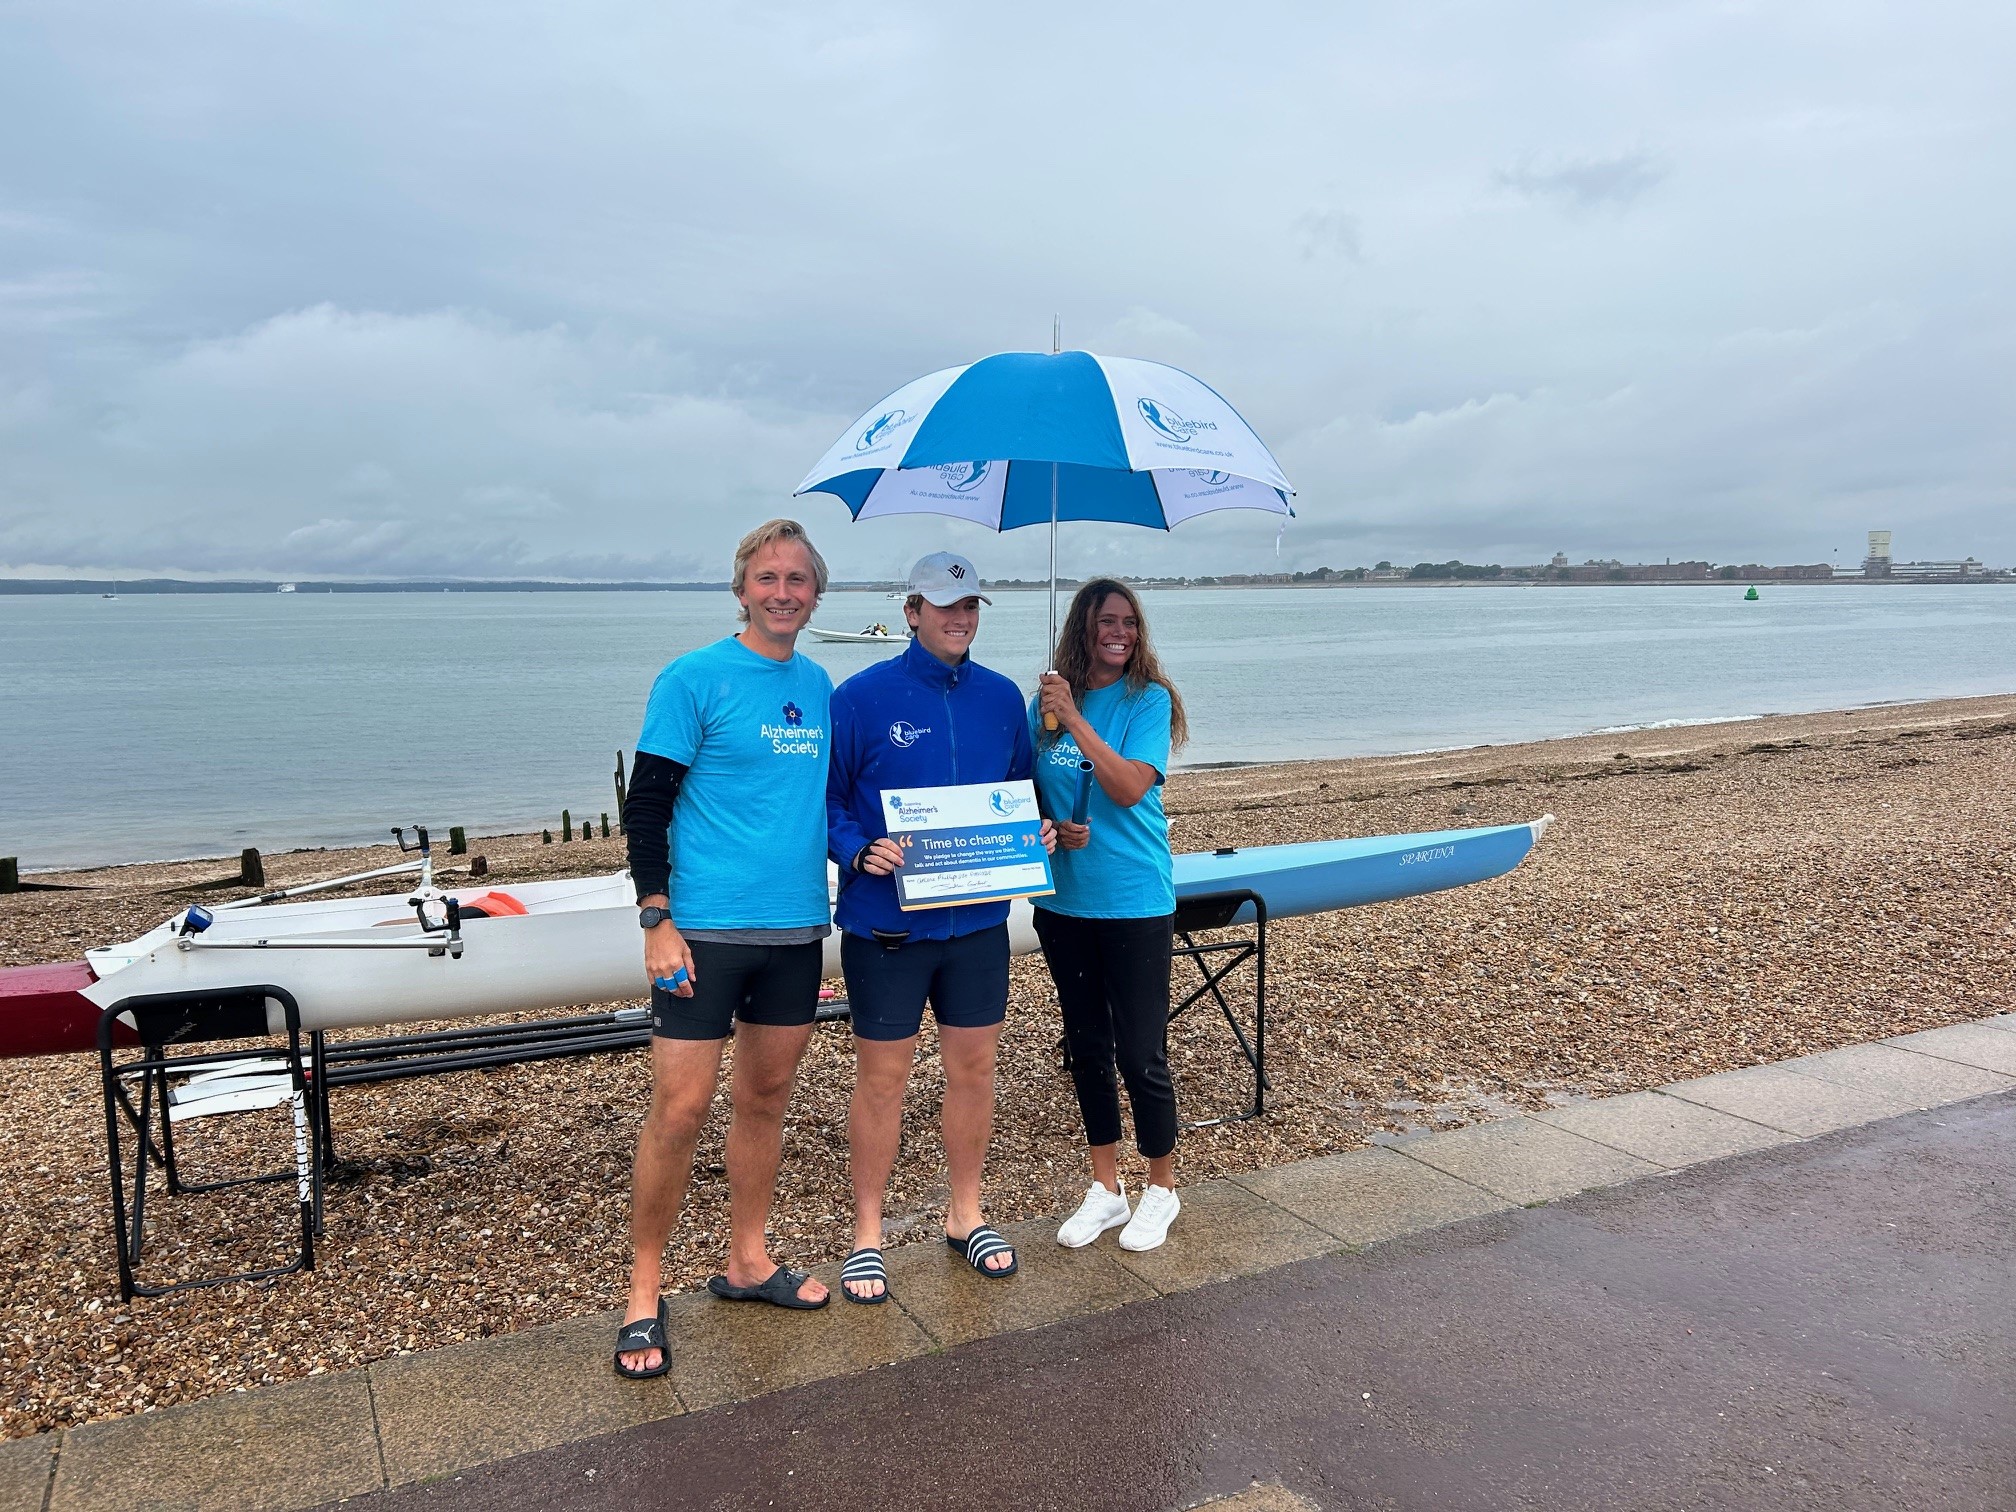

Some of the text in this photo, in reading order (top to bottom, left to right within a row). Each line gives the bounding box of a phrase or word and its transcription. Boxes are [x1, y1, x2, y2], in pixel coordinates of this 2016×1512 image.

[1165, 415, 1218, 431] bluebird
[1171, 425, 1198, 435] care
[760, 724, 823, 739] Alzheimer's
[904, 727, 931, 736] bluebird
[772, 739, 818, 759] Society
[1049, 752, 1080, 768] Soci
[1003, 797, 1031, 805] bluebird
[899, 805, 938, 815] Alzheimer's
[900, 815, 928, 823] Society
[921, 834, 1014, 850] Time to change
[957, 850, 975, 858] change
[1399, 845, 1455, 866] SPARTINA
